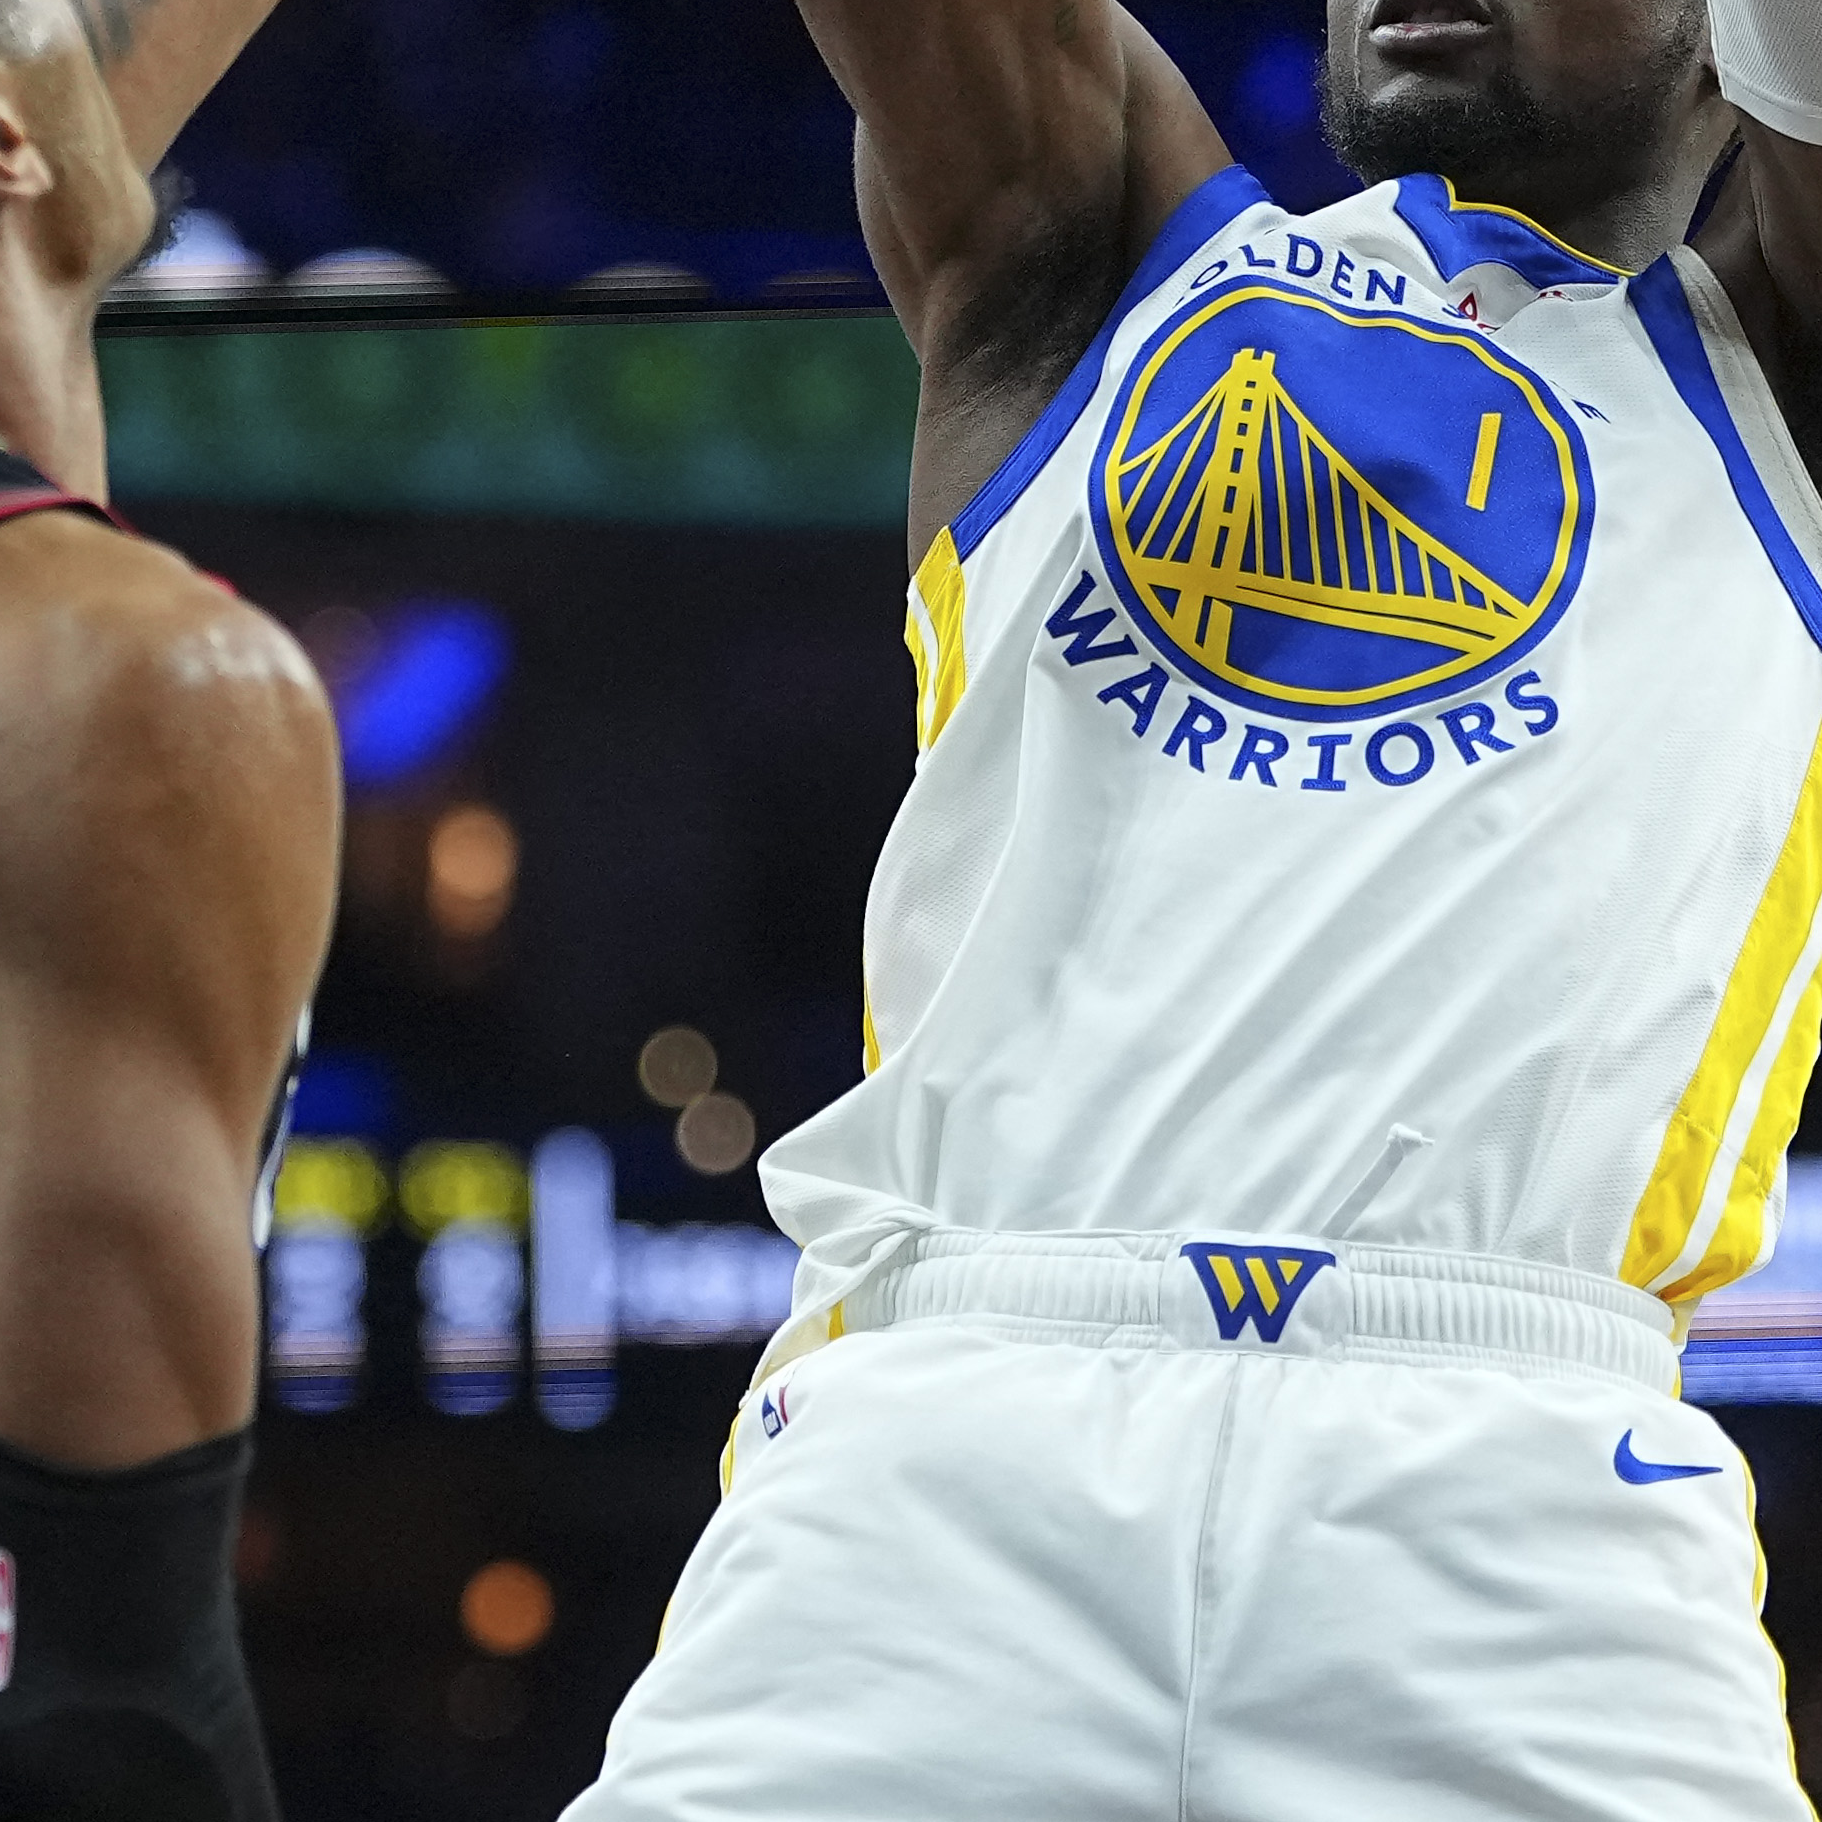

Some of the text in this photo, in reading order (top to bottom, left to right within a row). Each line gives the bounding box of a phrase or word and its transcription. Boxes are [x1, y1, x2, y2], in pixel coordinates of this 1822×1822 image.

[1173, 232, 1406, 310] OLDEN
[1044, 569, 1559, 792] WARRIORS
[1179, 1241, 1336, 1343] W
